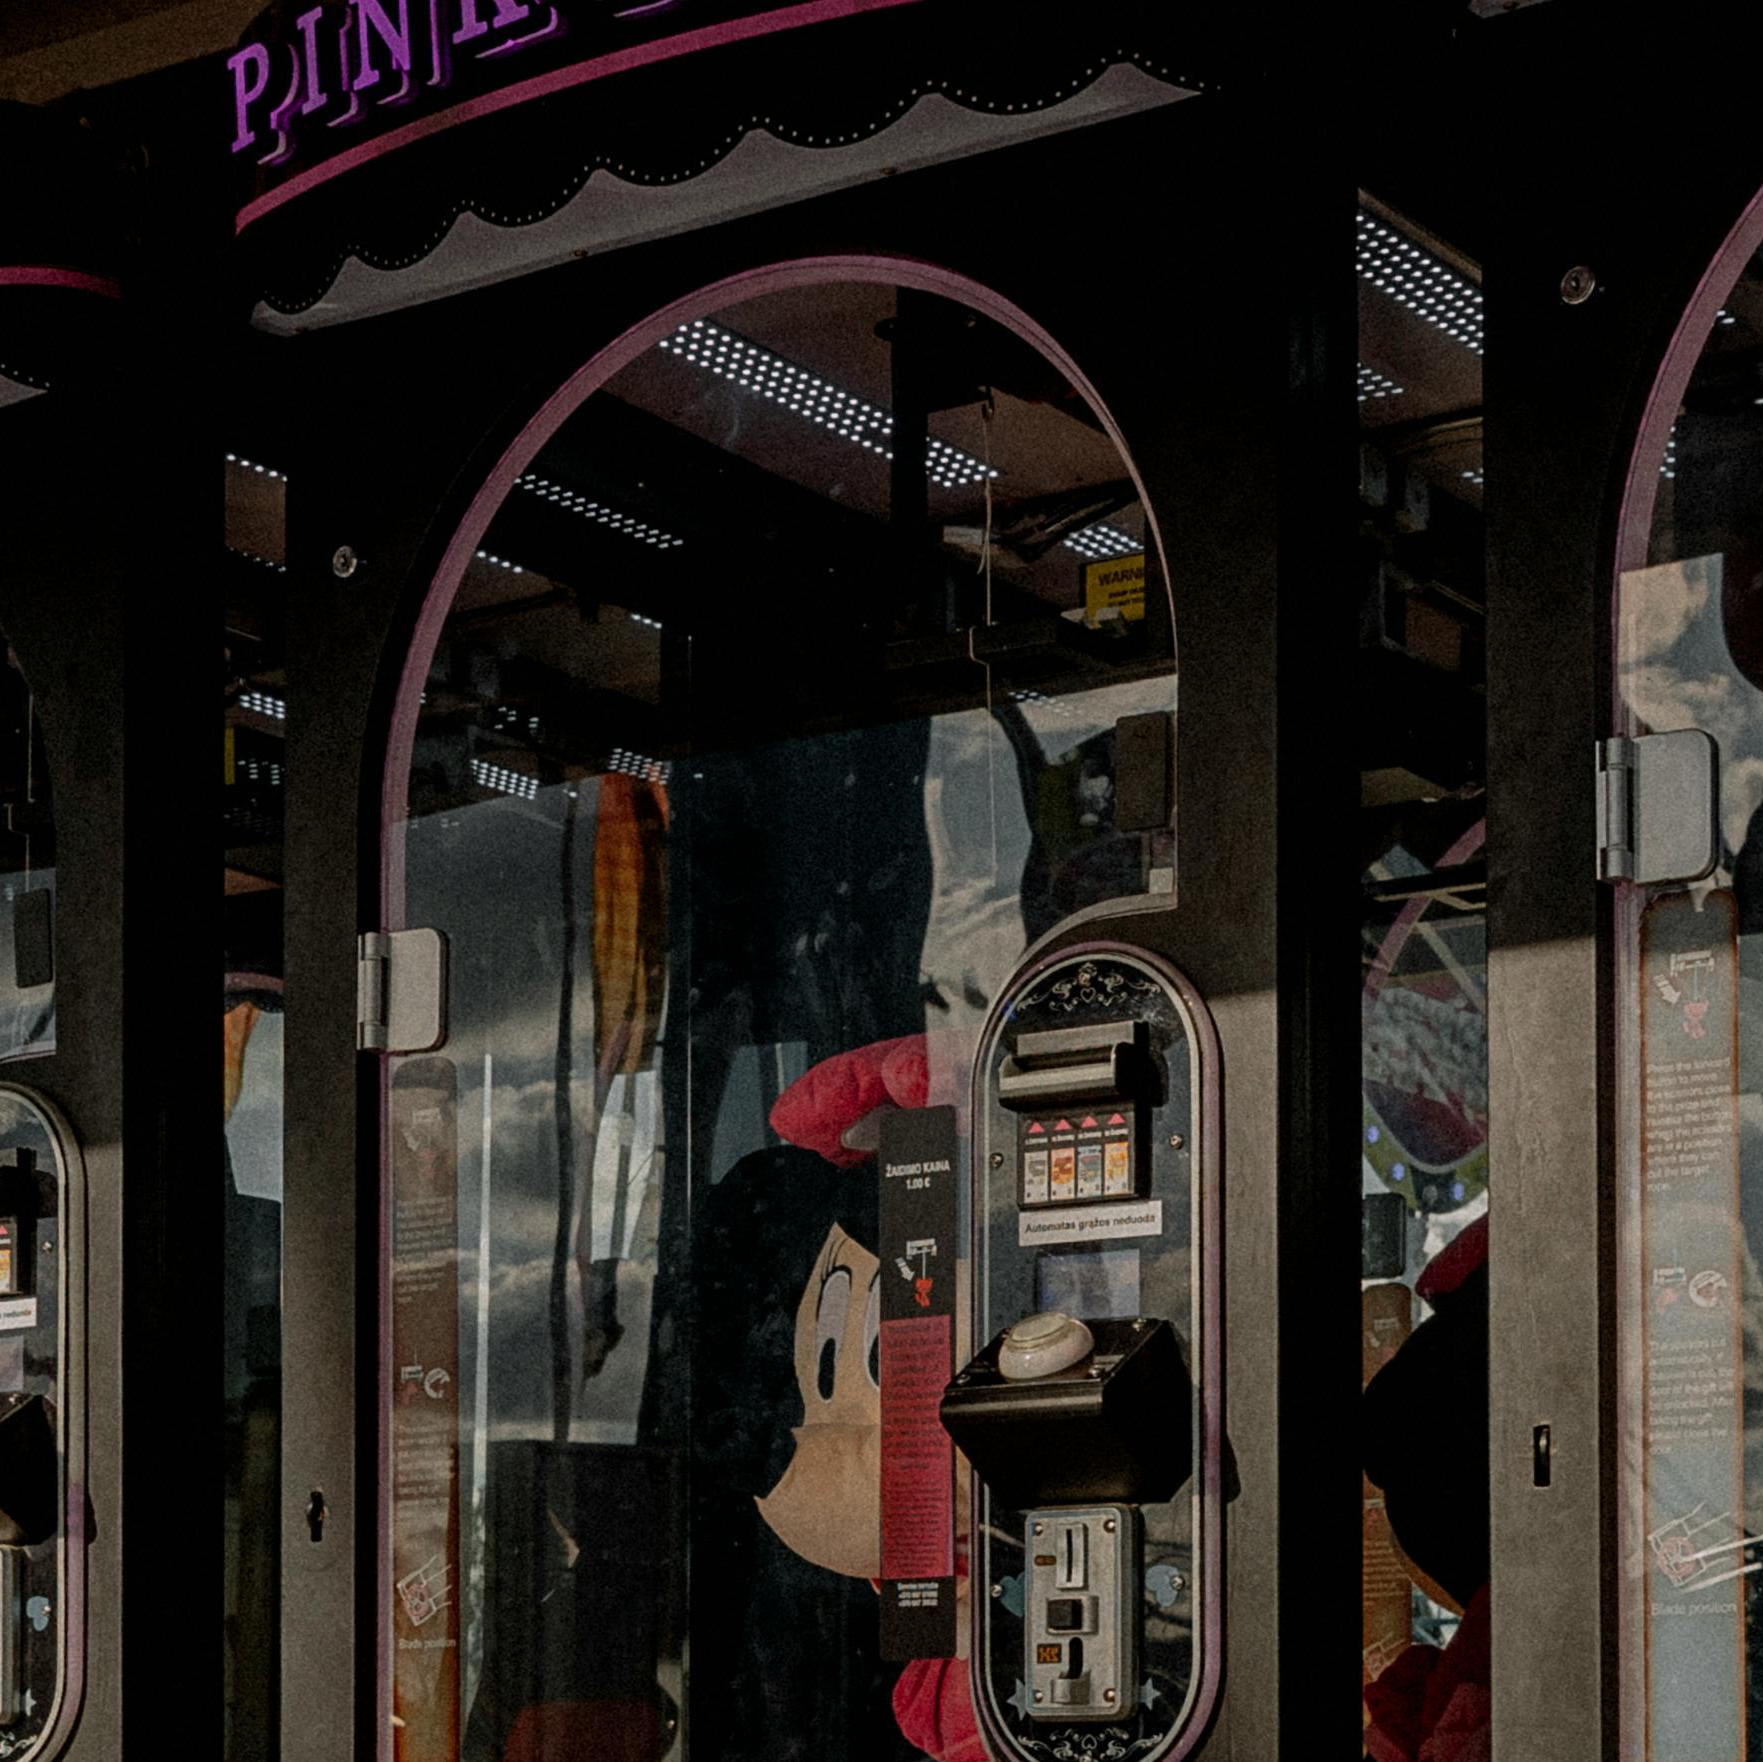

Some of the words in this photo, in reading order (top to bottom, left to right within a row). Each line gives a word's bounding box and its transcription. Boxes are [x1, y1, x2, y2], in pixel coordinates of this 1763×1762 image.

[885, 1162, 922, 1178] ŽAIDIMO
[922, 1160, 950, 1173] KAINA
[906, 1178, 923, 1190] 1.00
[1025, 1221, 1076, 1234] Automatas
[1113, 1214, 1156, 1228] neduoda
